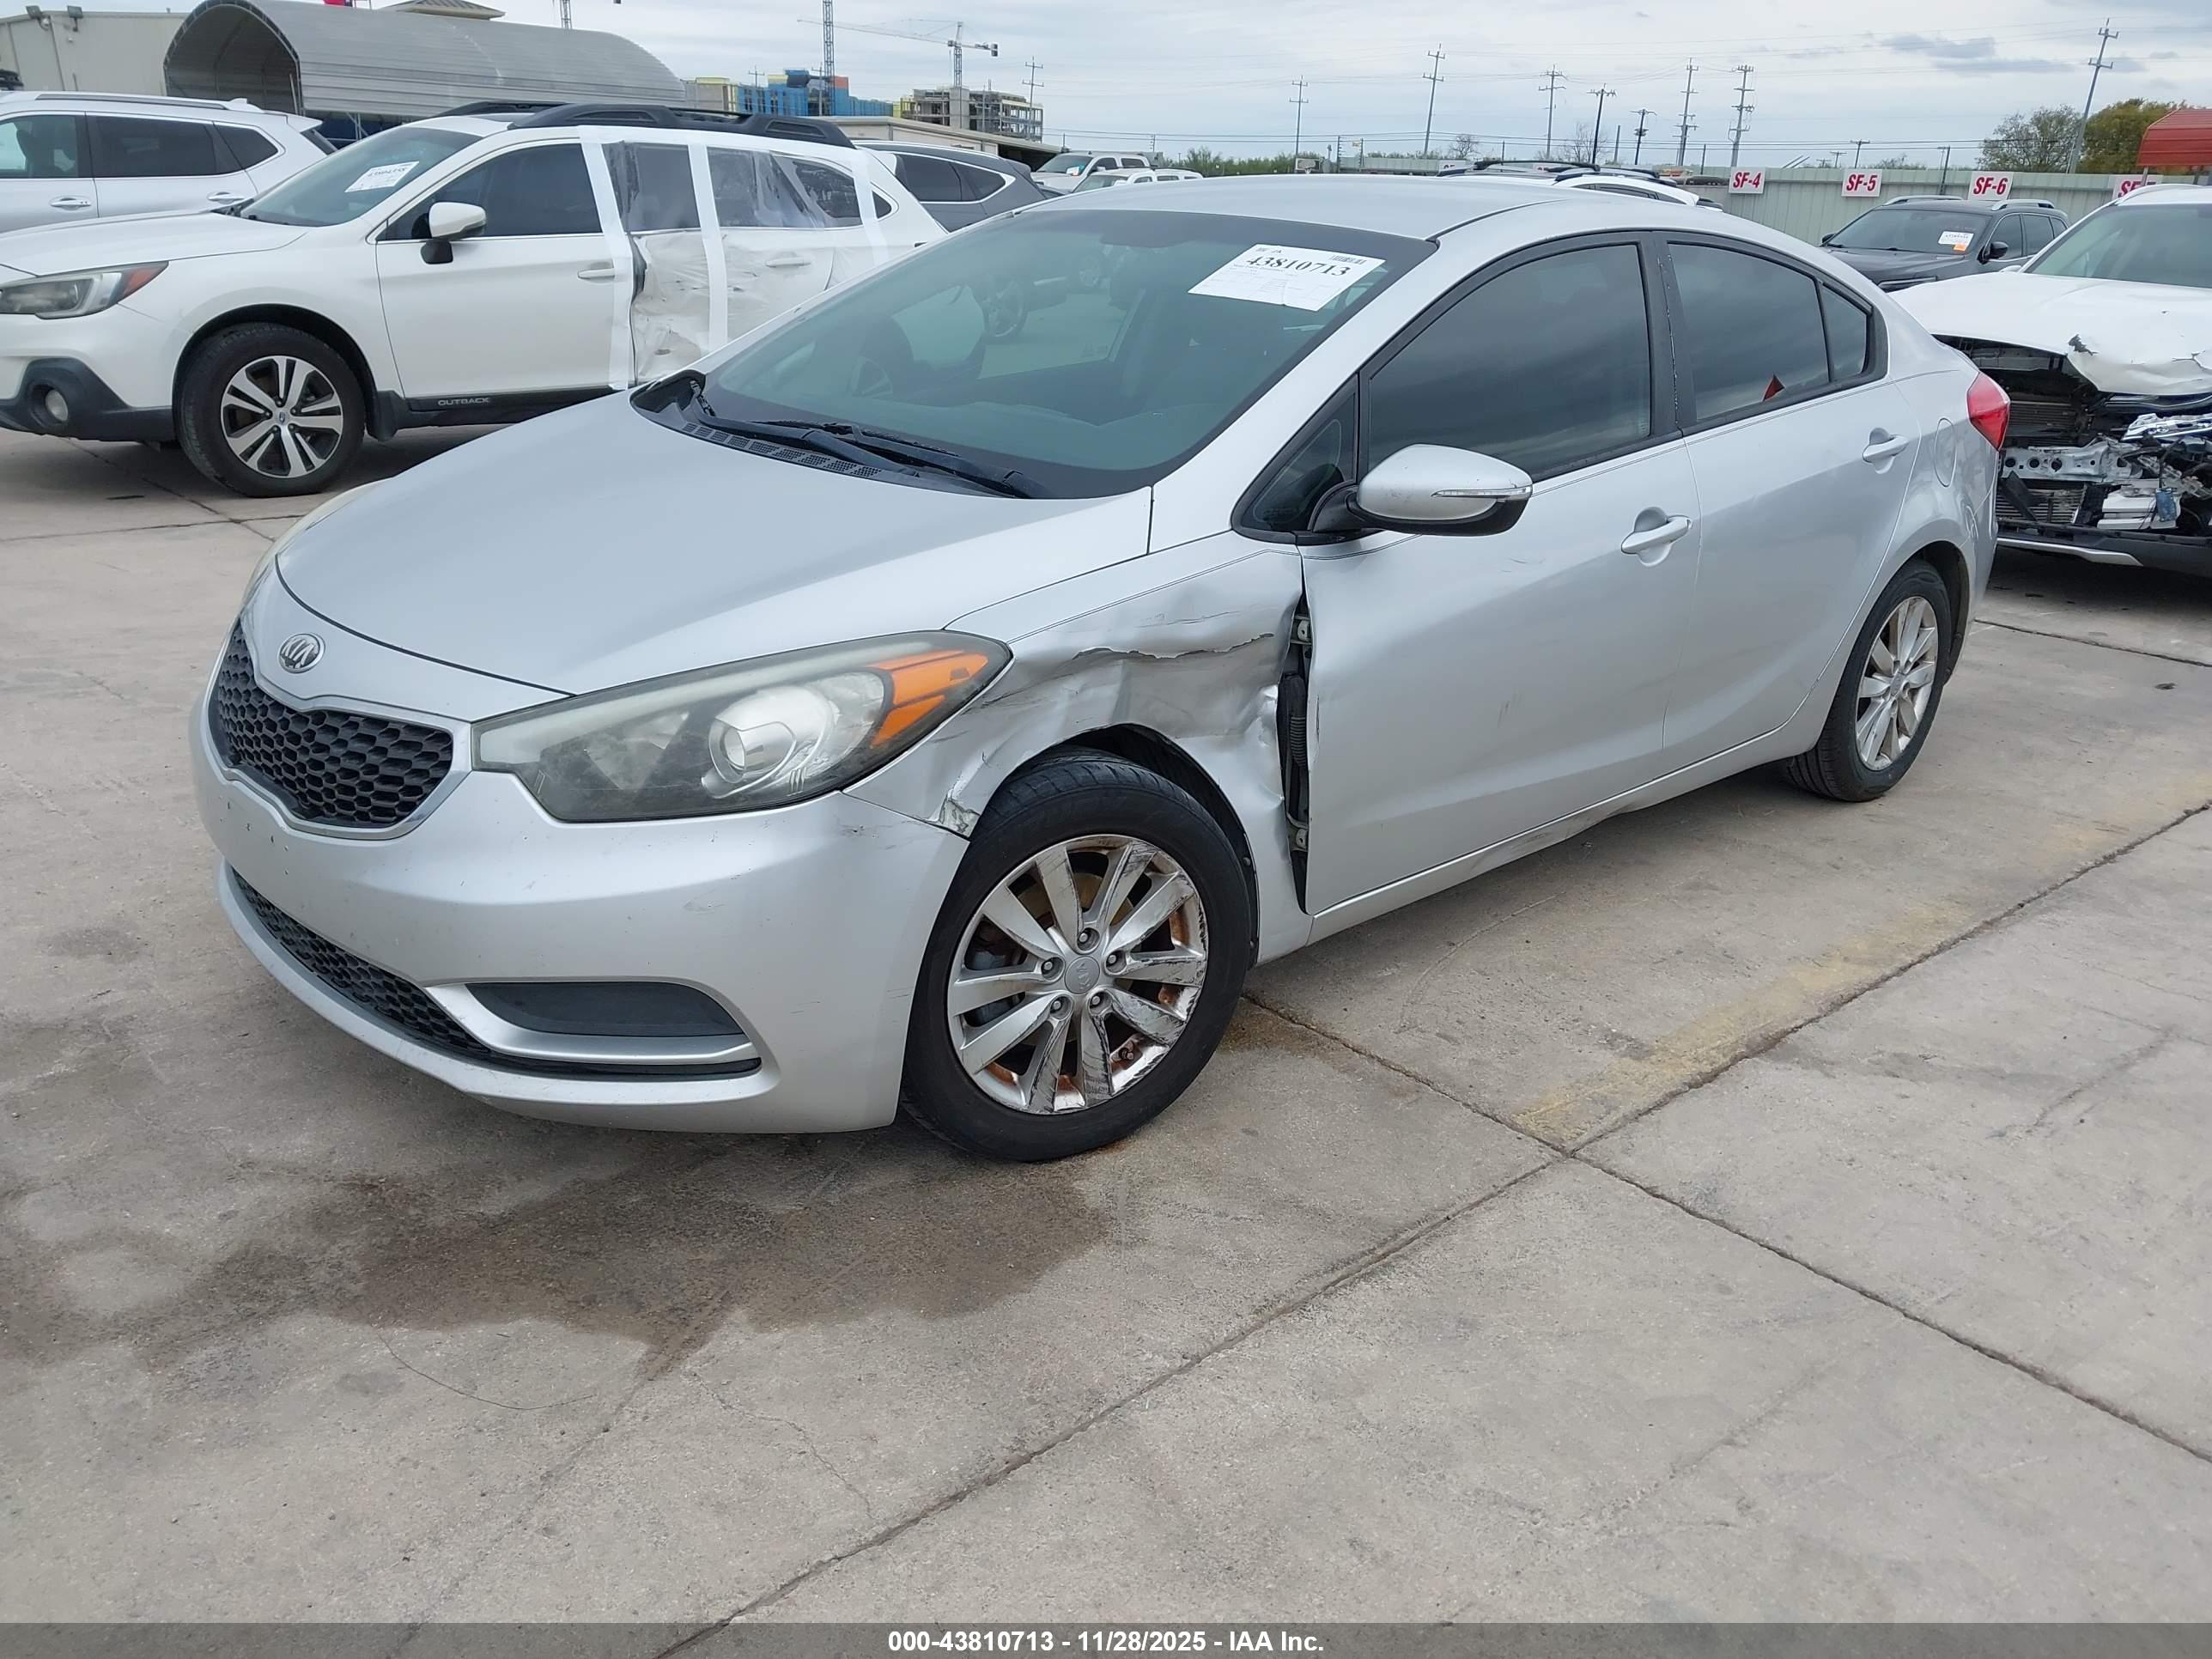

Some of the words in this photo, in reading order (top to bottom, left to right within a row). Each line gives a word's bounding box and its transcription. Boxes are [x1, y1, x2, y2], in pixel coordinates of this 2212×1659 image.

[1733, 172, 1762, 189] SF-4
[1846, 173, 1878, 191] SF-5
[1973, 176, 2008, 195] SF-6
[1247, 256, 1352, 276] 43810713
